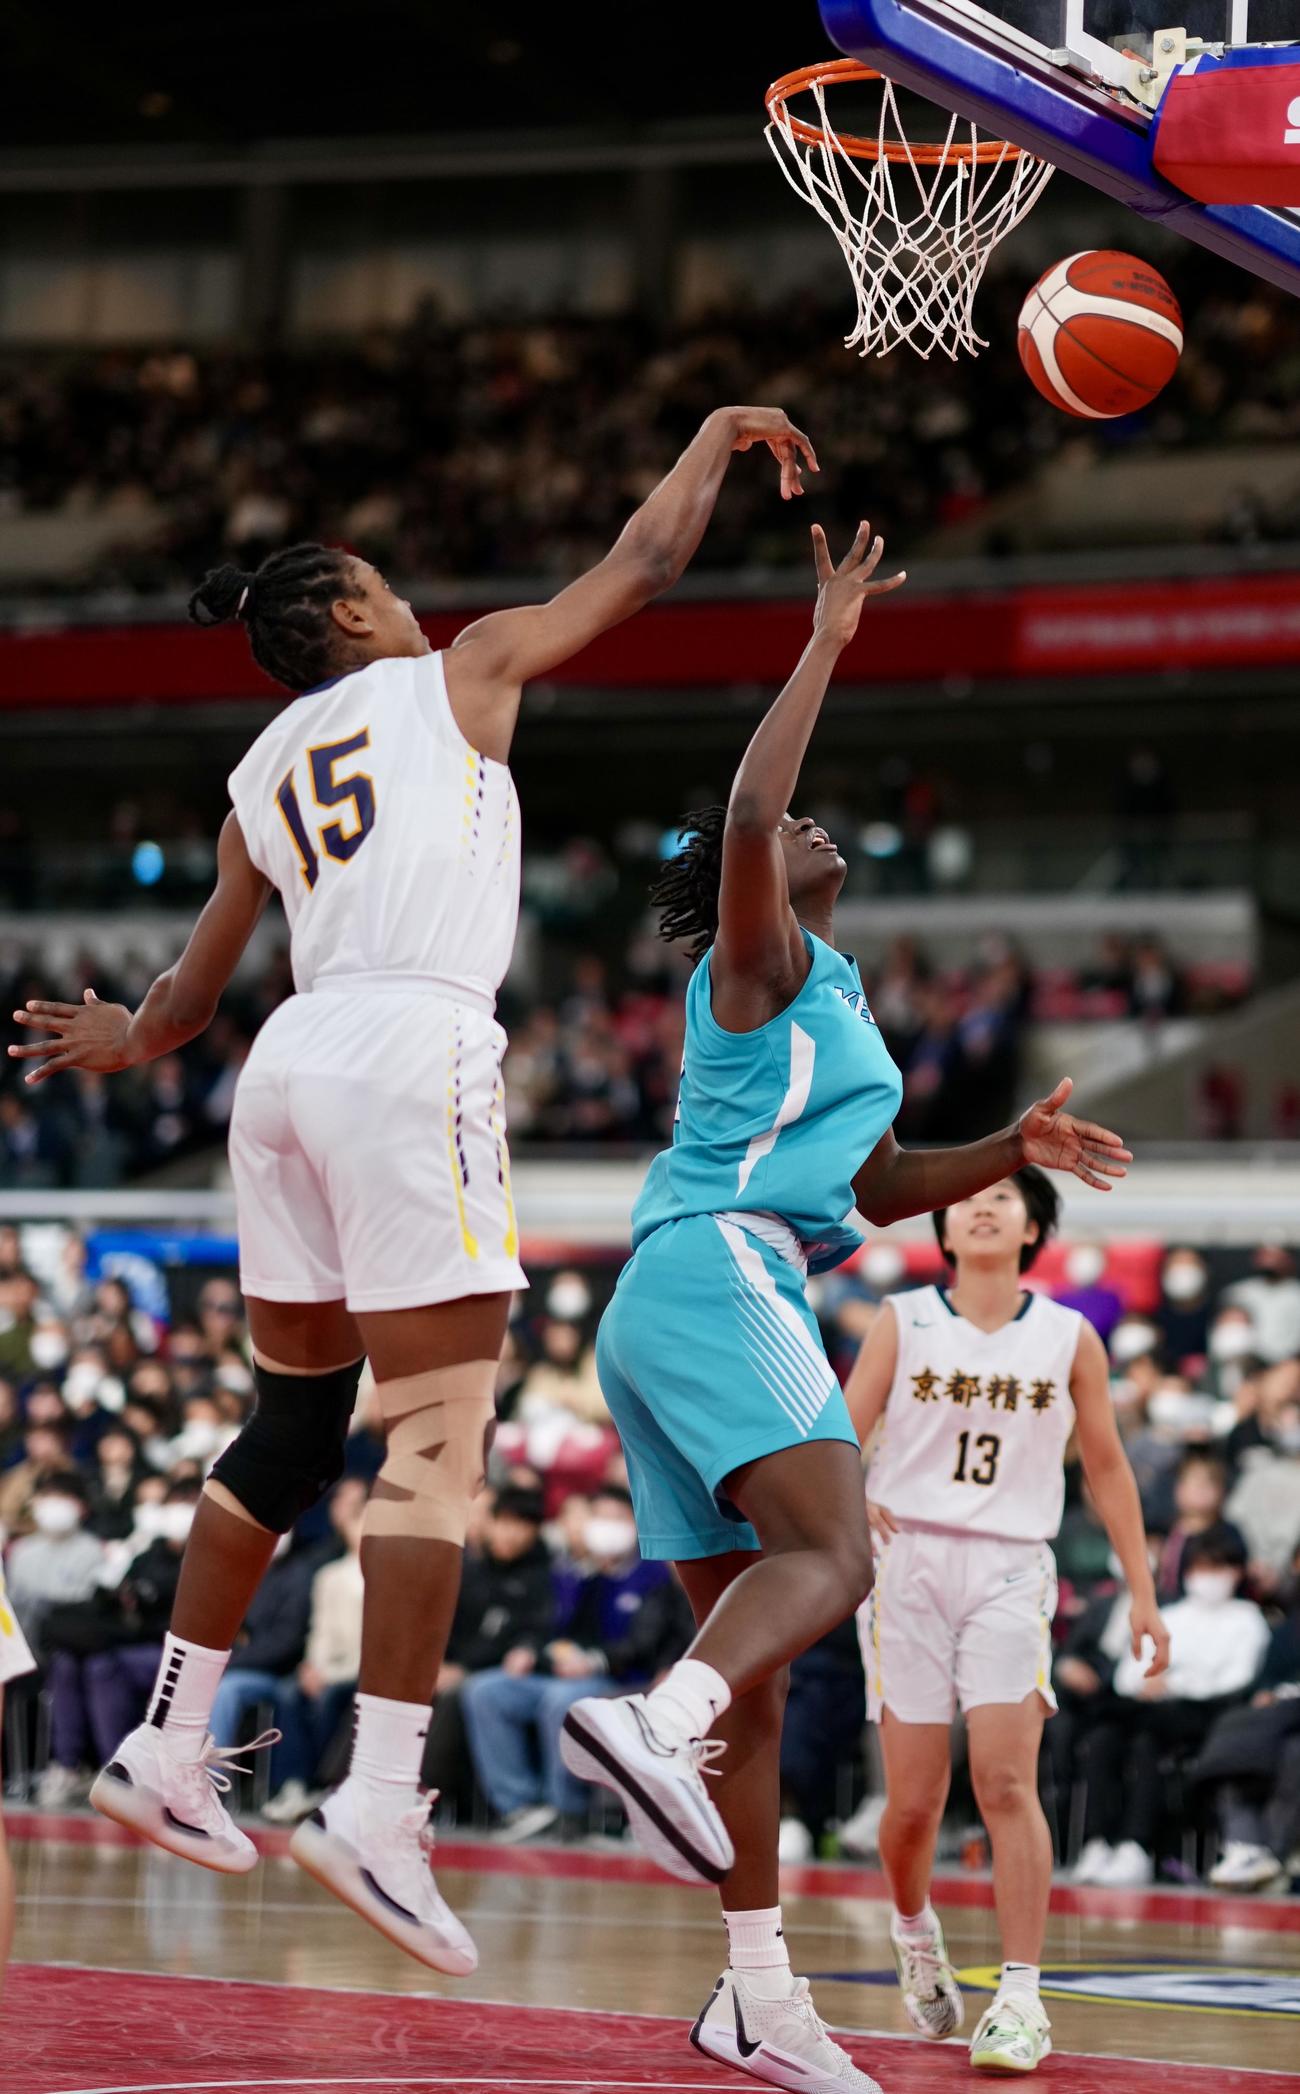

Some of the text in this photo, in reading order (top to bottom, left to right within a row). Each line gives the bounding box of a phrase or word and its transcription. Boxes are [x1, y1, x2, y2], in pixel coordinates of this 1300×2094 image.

[274, 725, 376, 894] 15
[909, 1365, 1057, 1416] 京都精華
[952, 1430, 1002, 1486] 13
